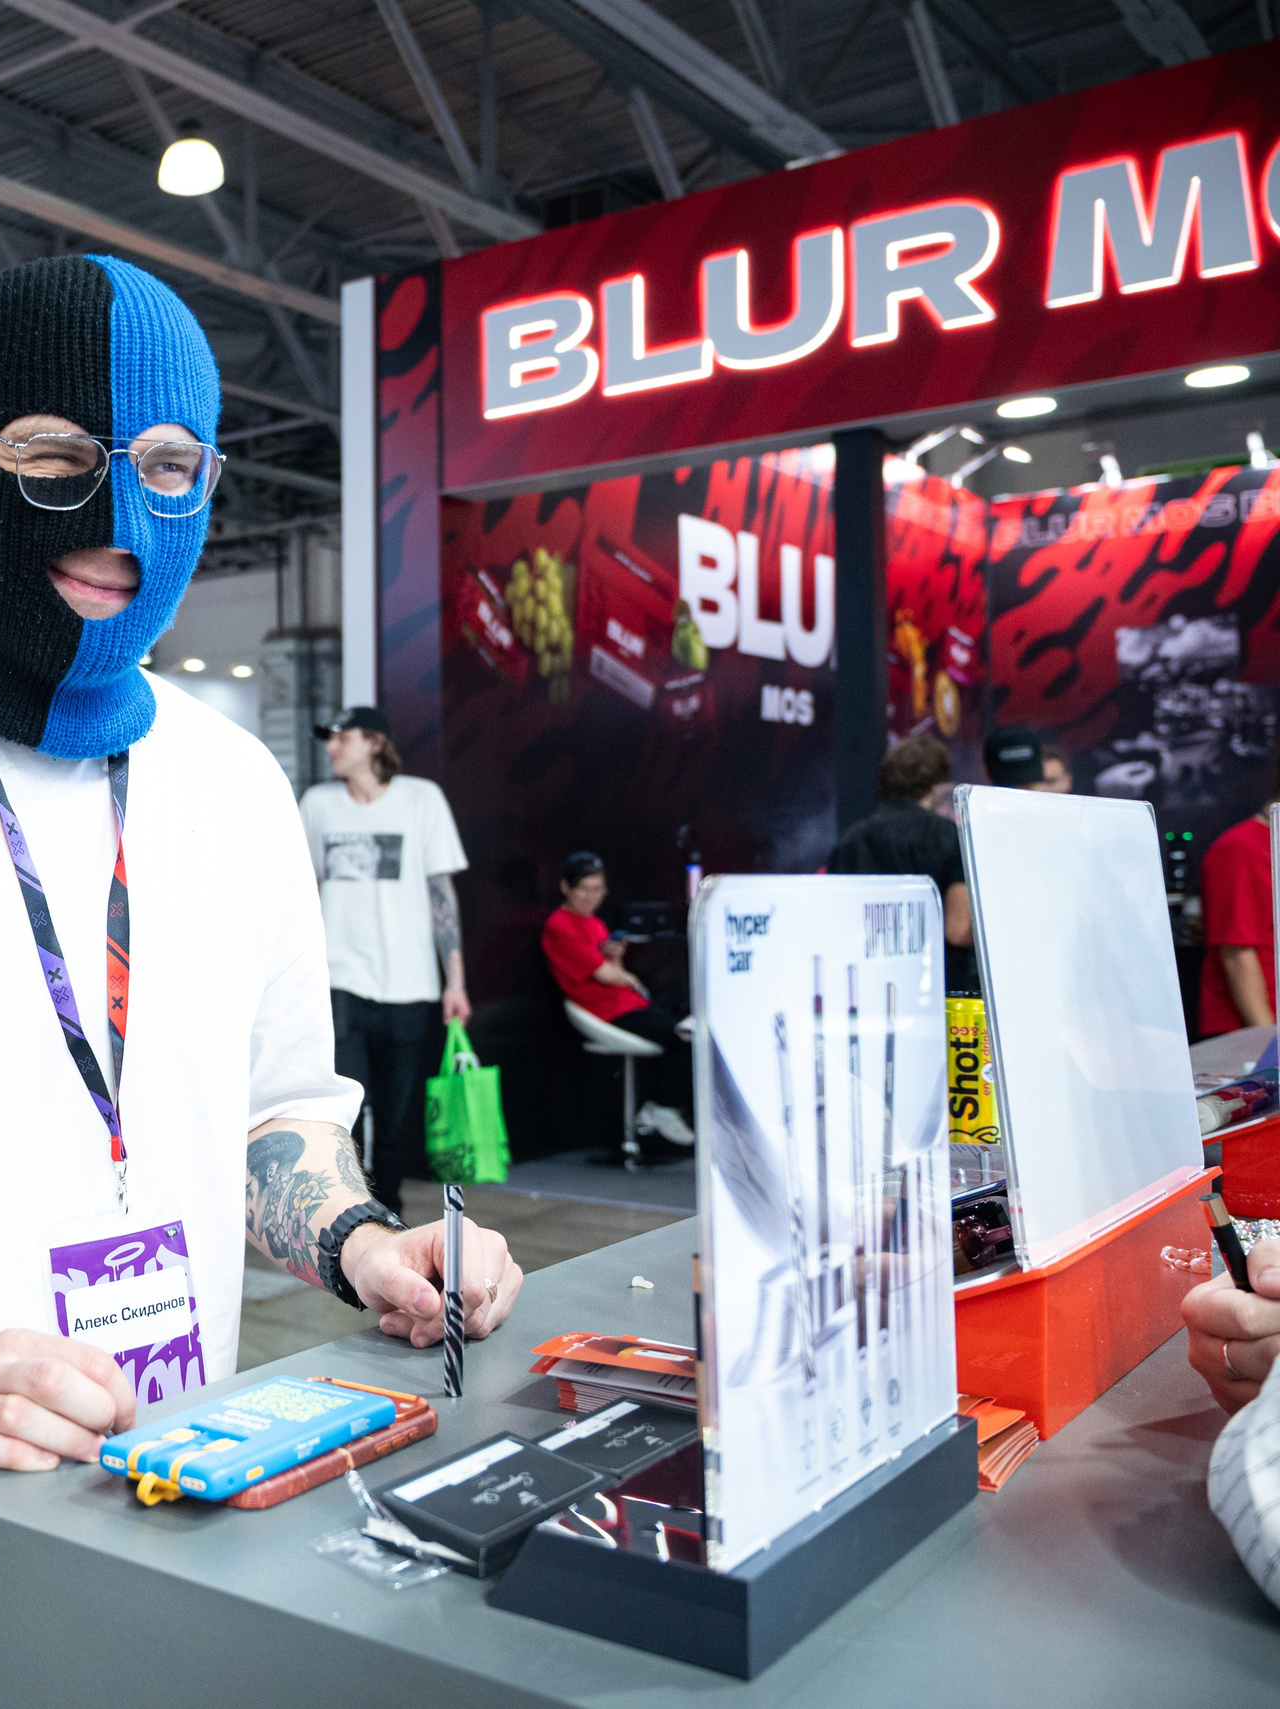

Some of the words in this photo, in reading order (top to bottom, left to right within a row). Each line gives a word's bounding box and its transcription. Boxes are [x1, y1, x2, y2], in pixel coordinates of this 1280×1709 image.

[483, 198, 998, 420] BLUR
[1044, 128, 1280, 309] M
[678, 512, 839, 672] BLU
[761, 683, 815, 727] MOS
[948, 1037, 980, 1121] Shot
[74, 1313, 118, 1333] Алекс
[121, 1296, 186, 1321] Скидонов
